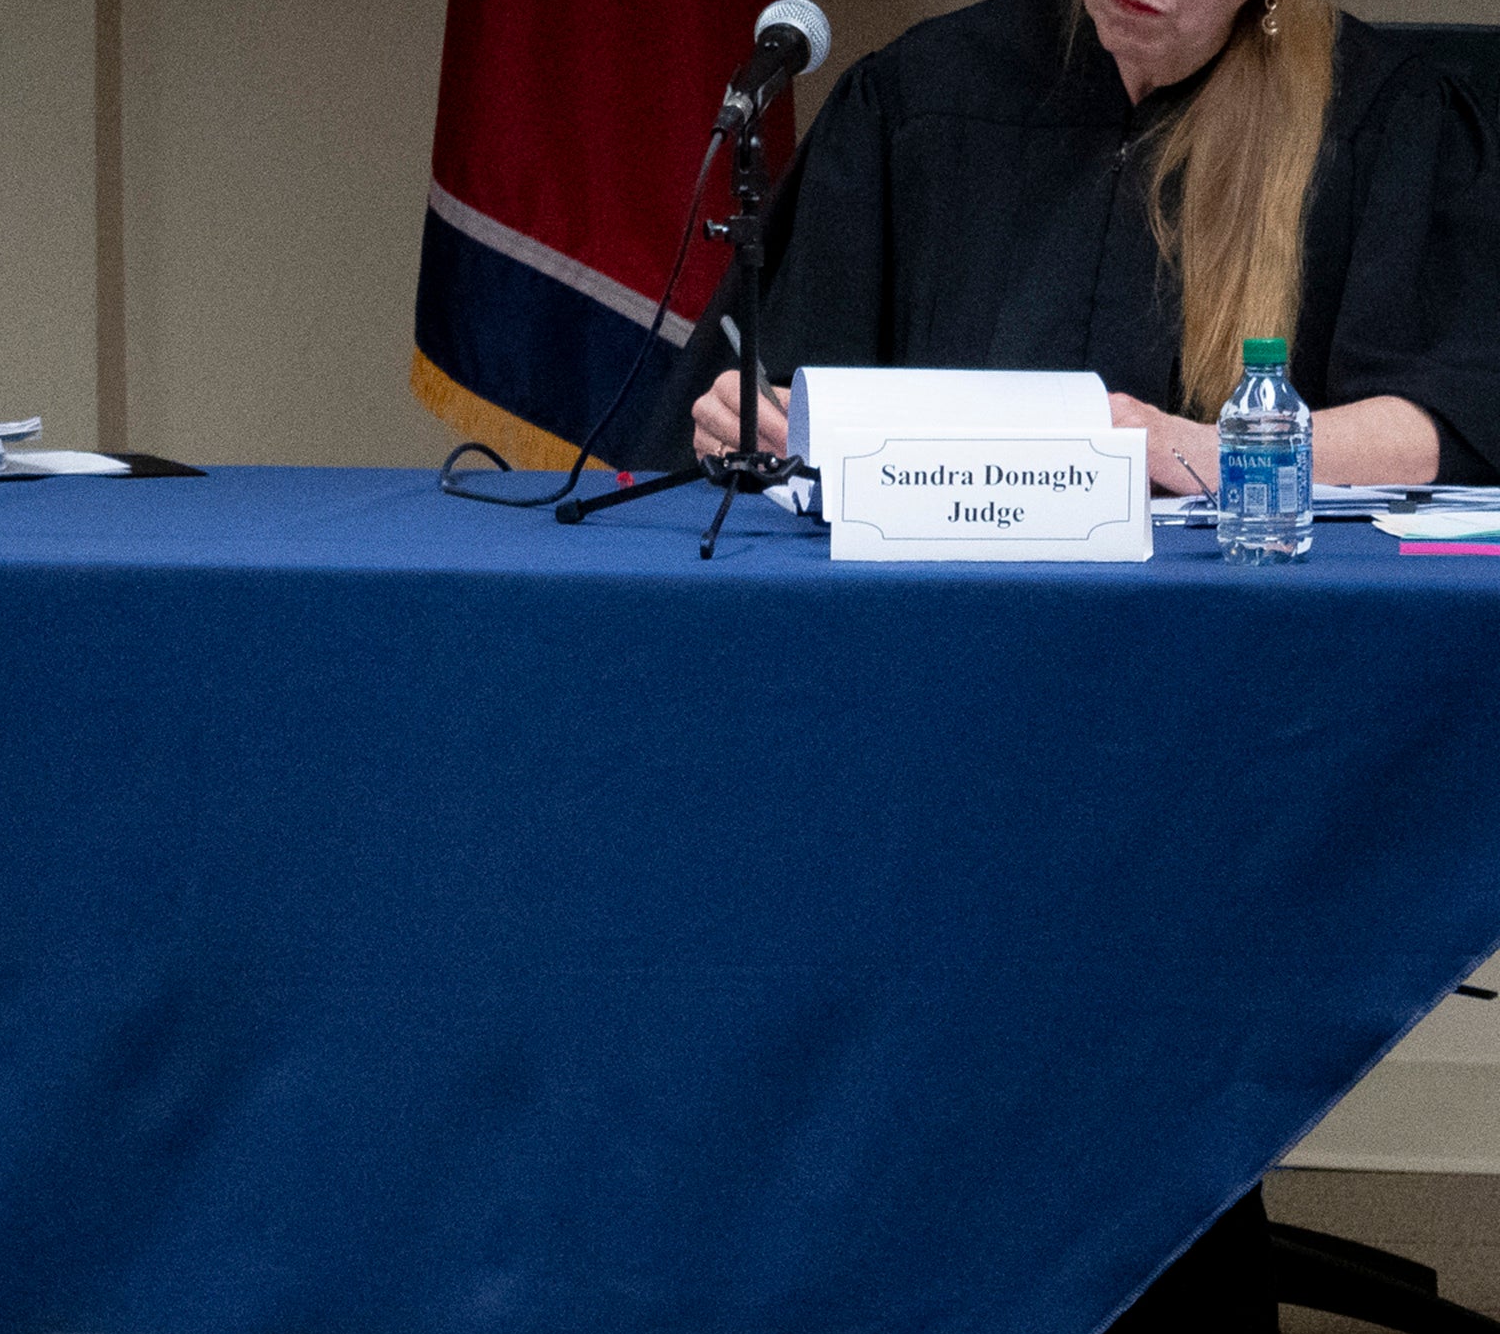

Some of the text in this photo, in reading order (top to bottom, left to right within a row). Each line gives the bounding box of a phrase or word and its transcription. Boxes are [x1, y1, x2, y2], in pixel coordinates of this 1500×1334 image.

[1228, 455, 1272, 470] DASANI
[881, 464, 1099, 492] Sandra Donaghy
[947, 501, 1026, 529] Judge
